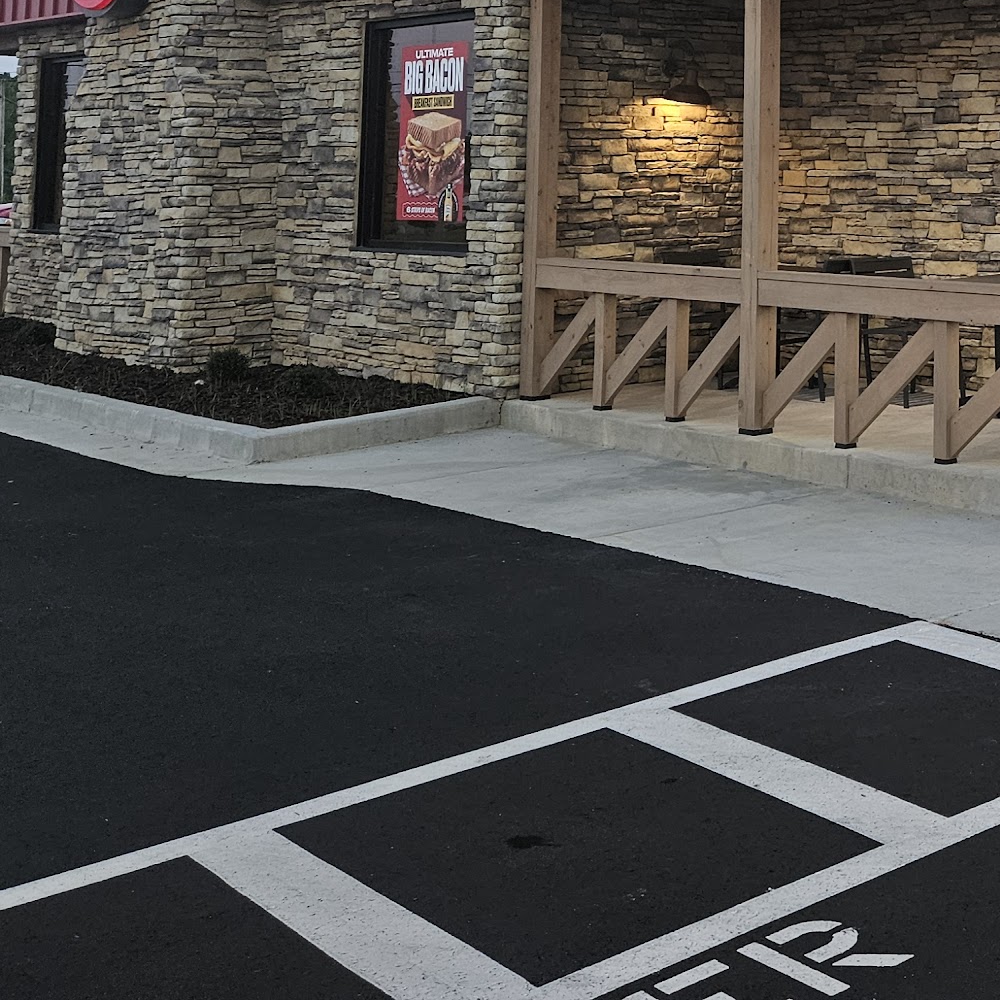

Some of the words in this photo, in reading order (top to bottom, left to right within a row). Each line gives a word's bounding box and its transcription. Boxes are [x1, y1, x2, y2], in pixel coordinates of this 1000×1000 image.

[416, 47, 454, 59] ULTIMATE
[404, 60, 424, 95] BIG
[425, 56, 464, 94] BACON
